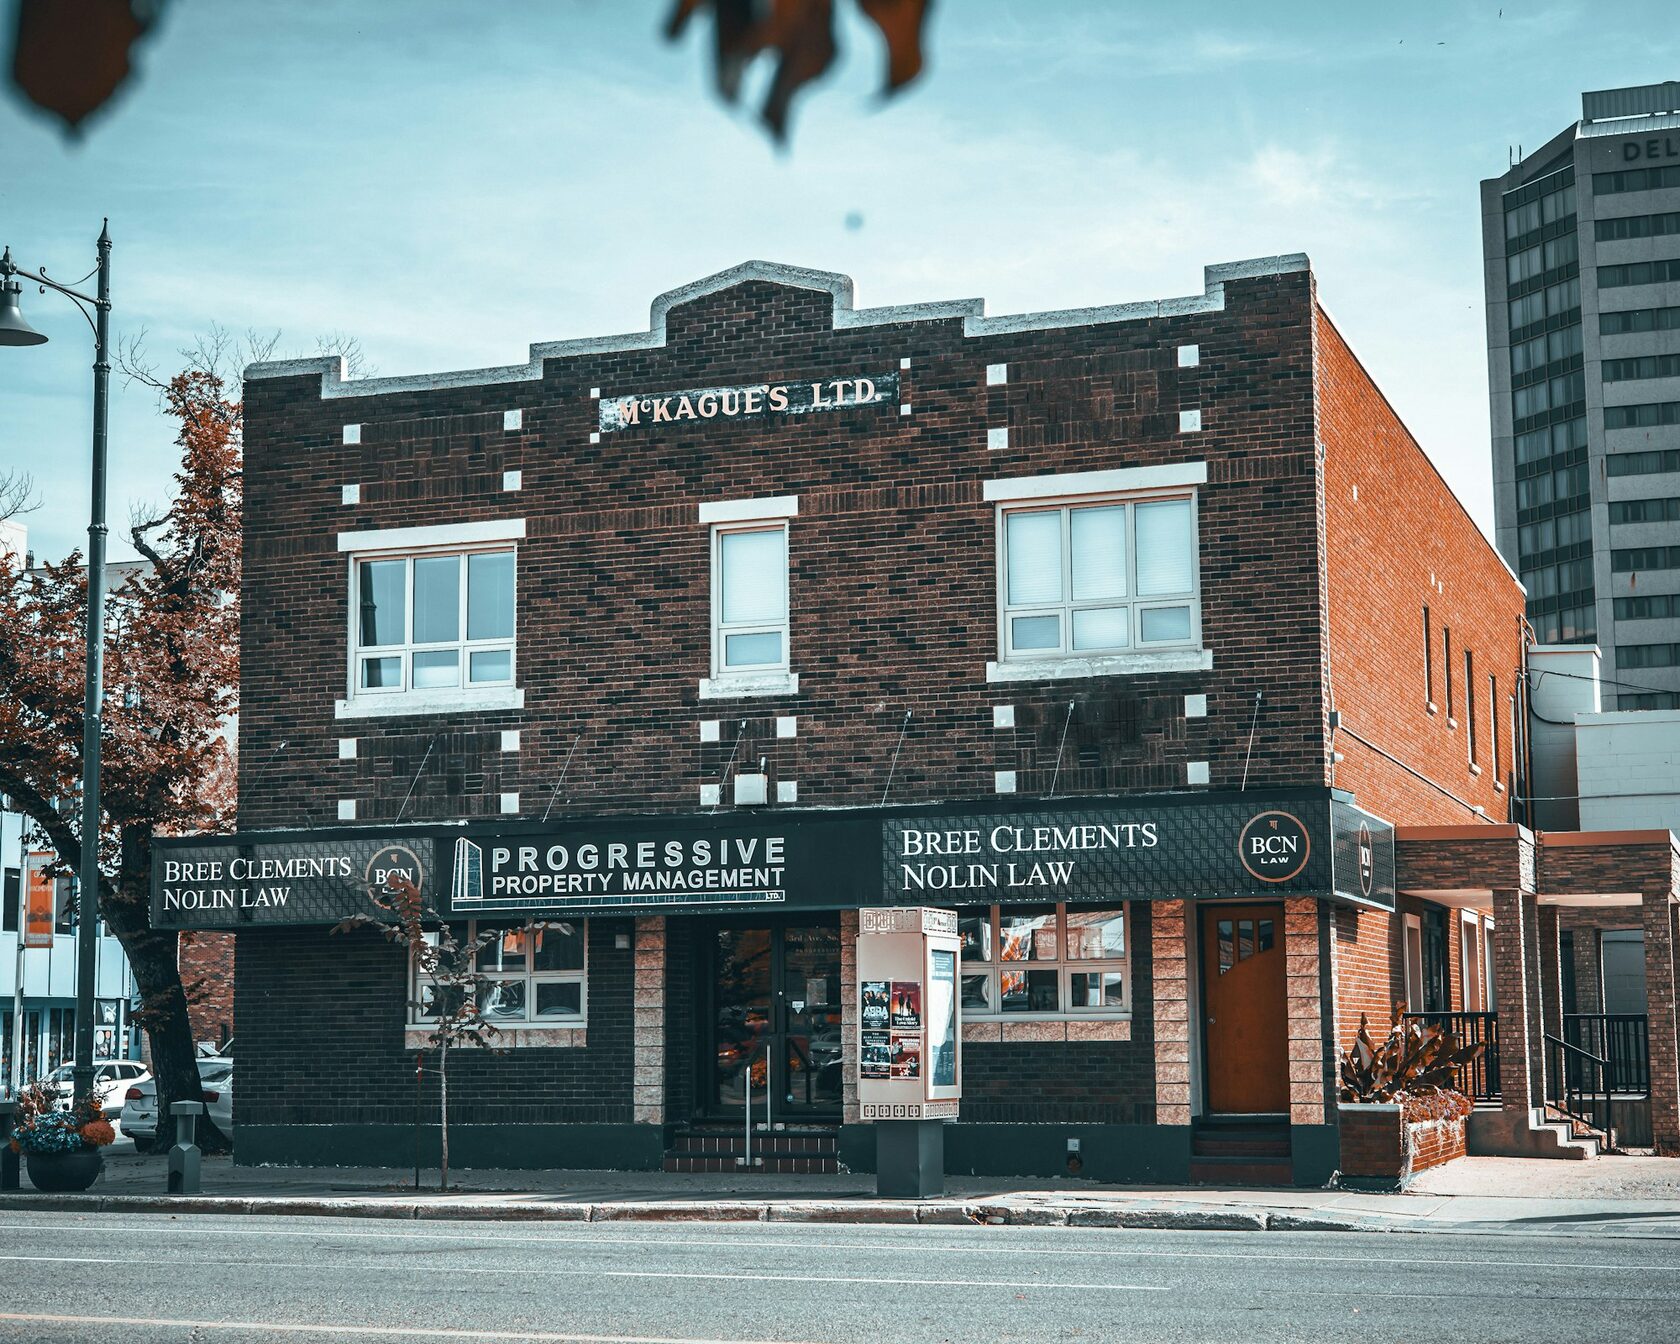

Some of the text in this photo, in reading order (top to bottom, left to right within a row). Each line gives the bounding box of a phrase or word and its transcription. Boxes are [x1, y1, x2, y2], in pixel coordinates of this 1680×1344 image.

[811, 378, 883, 408] LTD.
[901, 822, 1158, 856] BREE CLEMENTS
[1251, 835, 1298, 855] BCN
[492, 837, 785, 873] PROGRESSIVE
[1260, 856, 1289, 864] LAW
[164, 856, 351, 883] BREE CLEMENTS
[492, 867, 785, 895] PROPERTY MANAGEMENT
[902, 861, 1075, 890] NOLIN LAW
[163, 887, 291, 911] NOLIN LAW
